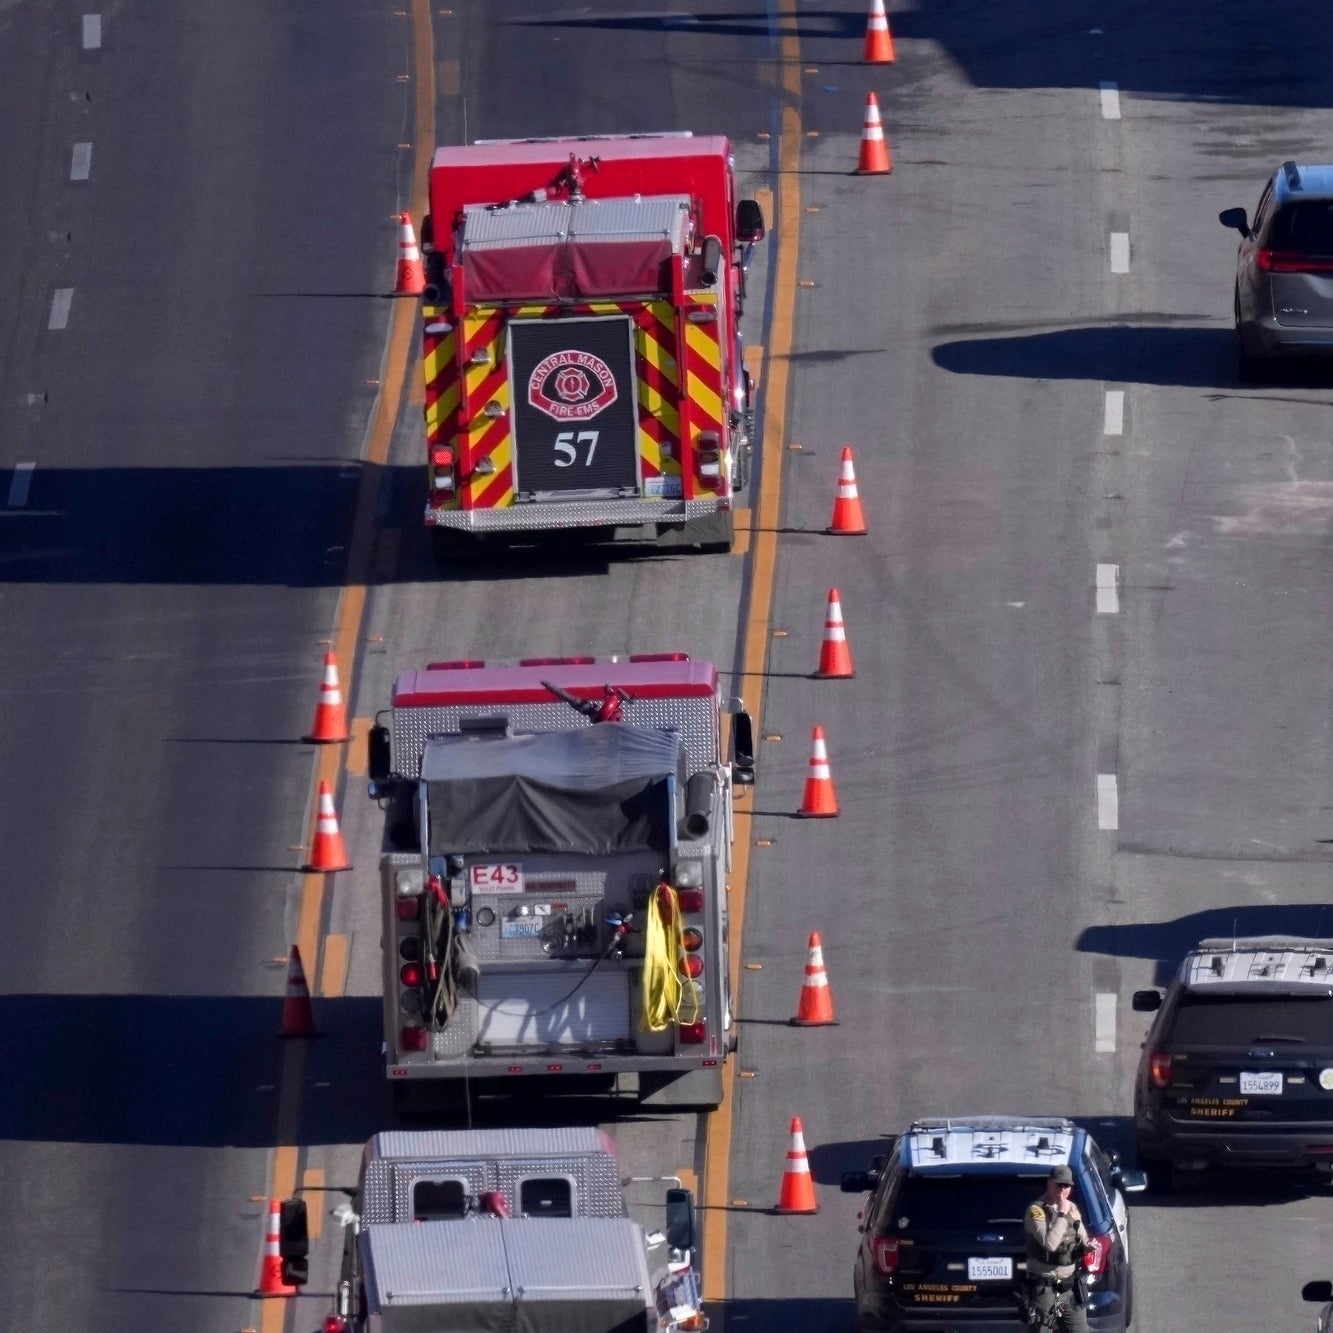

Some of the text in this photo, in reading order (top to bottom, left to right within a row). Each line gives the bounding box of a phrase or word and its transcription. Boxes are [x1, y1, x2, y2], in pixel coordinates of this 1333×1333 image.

[531, 353, 614, 389] CENTRAL MASON
[554, 431, 600, 467] 57
[473, 864, 519, 885] E43
[1190, 1107, 1235, 1117] SHERIFF
[972, 1265, 1009, 1277] 1555001
[918, 1284, 949, 1292] ANGELES
[914, 1294, 960, 1303] SHERIFF
